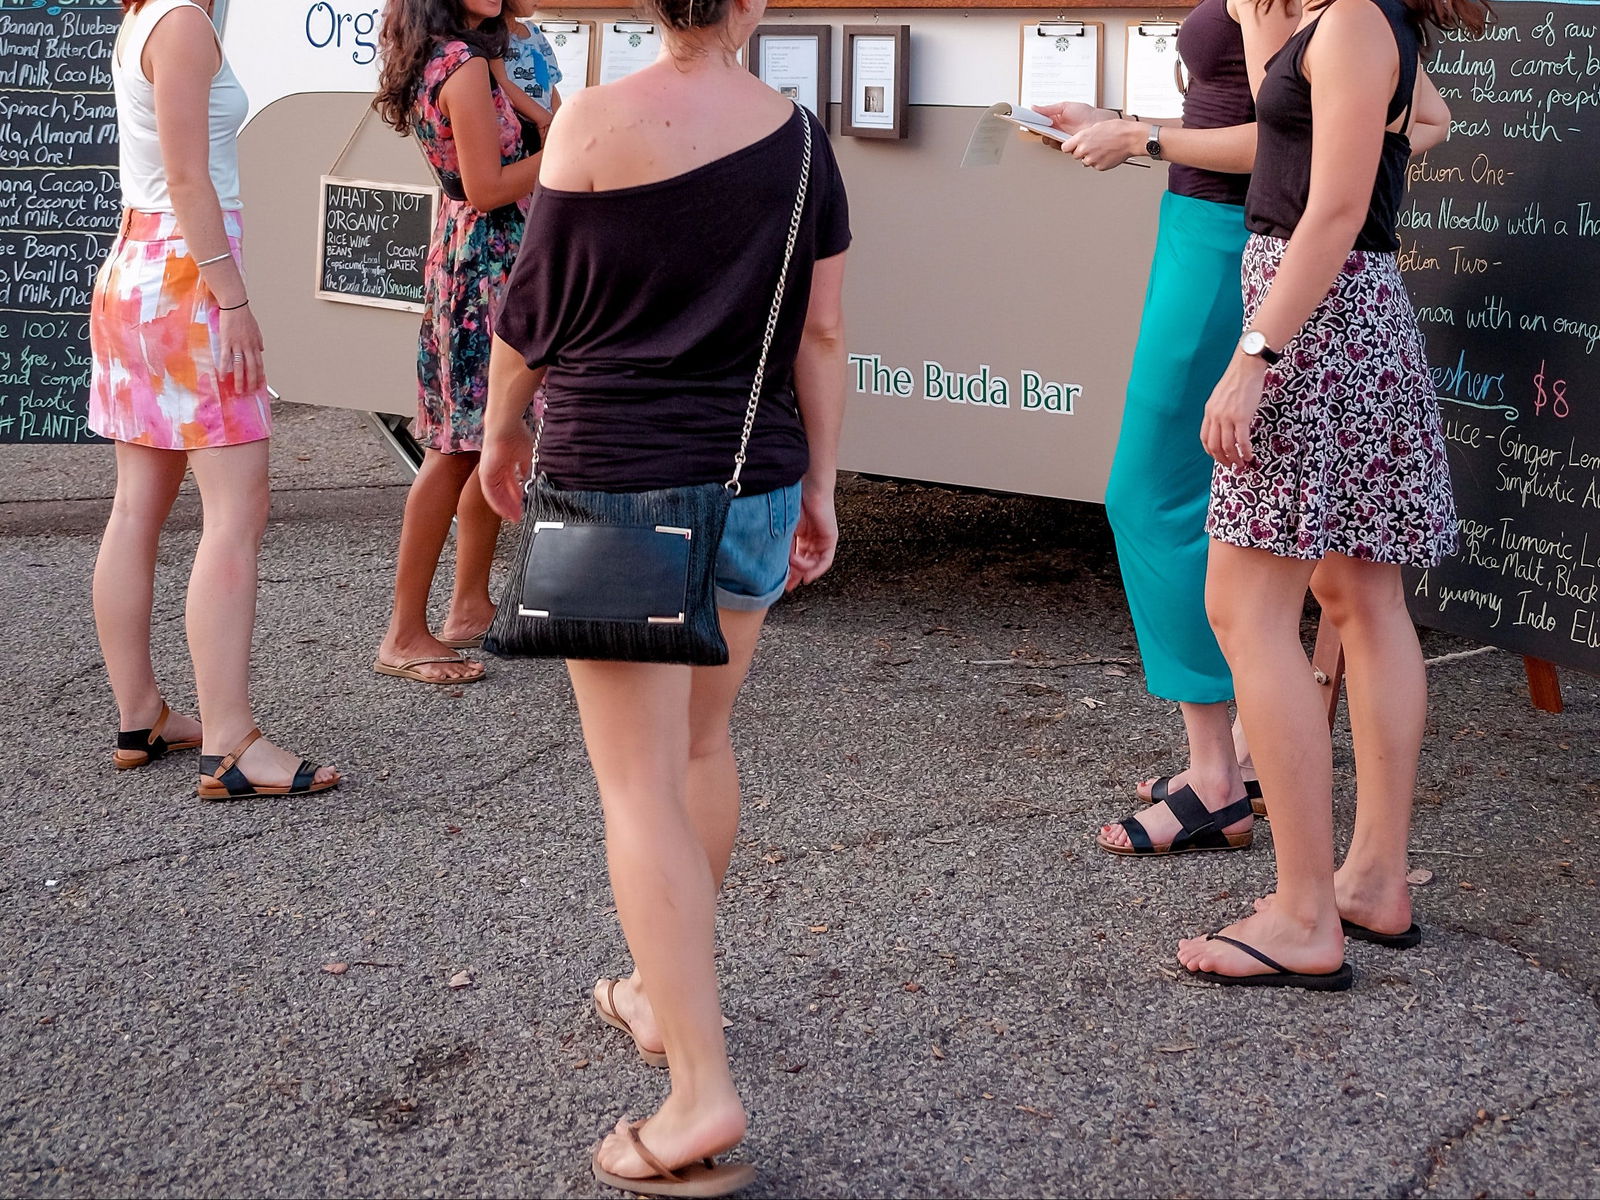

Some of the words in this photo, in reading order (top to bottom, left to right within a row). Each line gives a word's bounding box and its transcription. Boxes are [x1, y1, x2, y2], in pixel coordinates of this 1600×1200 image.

[61, 12, 121, 38] Blueber
[305, 1, 379, 65] Org
[1531, 11, 1555, 46] of
[1564, 23, 1597, 38] raw
[87, 40, 113, 59] Chi
[0, 60, 18, 85] nd
[19, 60, 53, 90] Milk,
[55, 63, 87, 83] Coco
[1420, 49, 1496, 91] cluding
[1438, 87, 1463, 99] en
[1471, 77, 1543, 108] beans,
[1547, 84, 1600, 114] pepi
[0, 123, 28, 148] lla,
[29, 120, 94, 146] Almond
[1503, 111, 1562, 143] with
[35, 145, 73, 166] One!
[0, 179, 37, 196] ana,
[40, 172, 99, 195] Cacao,
[1404, 150, 1465, 193] ption
[26, 195, 87, 210] Coconut
[94, 193, 123, 211] Pas
[328, 186, 384, 212] WHAT'S
[392, 192, 424, 212] NOT
[25, 209, 63, 228] Milk,
[65, 210, 121, 228] Coconut
[326, 210, 400, 233] ORGANIC?
[1438, 197, 1499, 234] Noodles
[1507, 202, 1546, 235] with
[1554, 220, 1568, 235] a
[1577, 202, 1600, 237] Tha
[0, 244, 16, 255] ee
[23, 235, 82, 263] Beans,
[85, 233, 112, 261] Da
[326, 245, 353, 258] BEANS
[327, 231, 348, 246] RICE
[386, 240, 427, 259] COCONUT
[14, 260, 79, 284] Vanilla
[386, 259, 419, 273] WATER
[1448, 246, 1488, 275] Two
[19, 283, 57, 309] Milk,
[59, 286, 92, 308] Moc
[385, 273, 427, 299] (SMOOTHIE
[22, 320, 70, 339] 100%
[1415, 306, 1455, 326] noa
[1466, 296, 1511, 330] with
[1519, 312, 1547, 331] an
[1553, 317, 1600, 354] orang
[848, 353, 914, 398] The
[923, 360, 1010, 408] Buda
[1020, 370, 1083, 415] Bar
[1533, 359, 1569, 418] $8
[20, 387, 75, 416] plastic
[1440, 407, 1480, 448] uice
[1569, 437, 1600, 469] Lem
[1496, 463, 1575, 508] Simplistic
[1456, 518, 1496, 547] nger,
[1468, 541, 1500, 569] Rice
[1501, 552, 1552, 592] Malt,
[1556, 565, 1599, 604] Black
[1414, 569, 1428, 597] A
[1438, 585, 1502, 628] yummy
[1513, 590, 1556, 631] Indo
[1570, 608, 1600, 648] Eli
